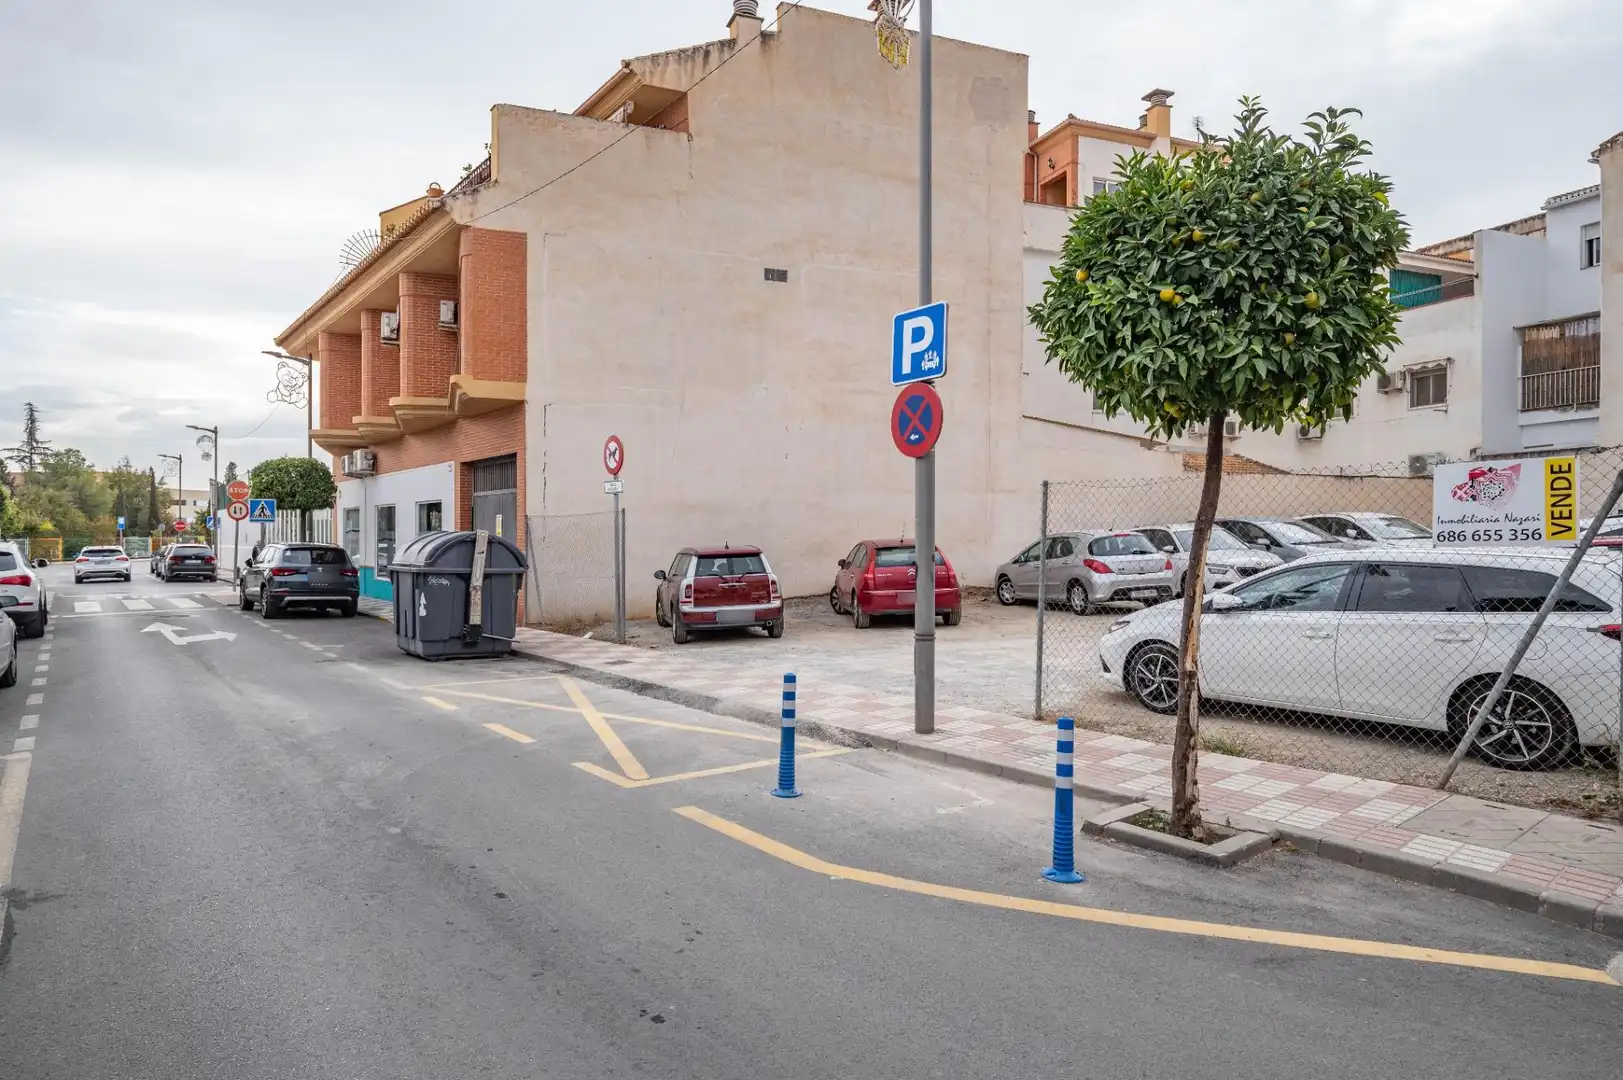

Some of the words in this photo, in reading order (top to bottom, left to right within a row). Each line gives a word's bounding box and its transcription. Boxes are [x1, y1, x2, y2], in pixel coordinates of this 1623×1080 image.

[902, 316, 934, 375] P
[1550, 463, 1573, 537] VENDE
[1436, 530, 1467, 542] 686
[1471, 529, 1503, 542] 655
[1508, 528, 1542, 541] 356
[1437, 513, 1500, 525] Inmobiliaria
